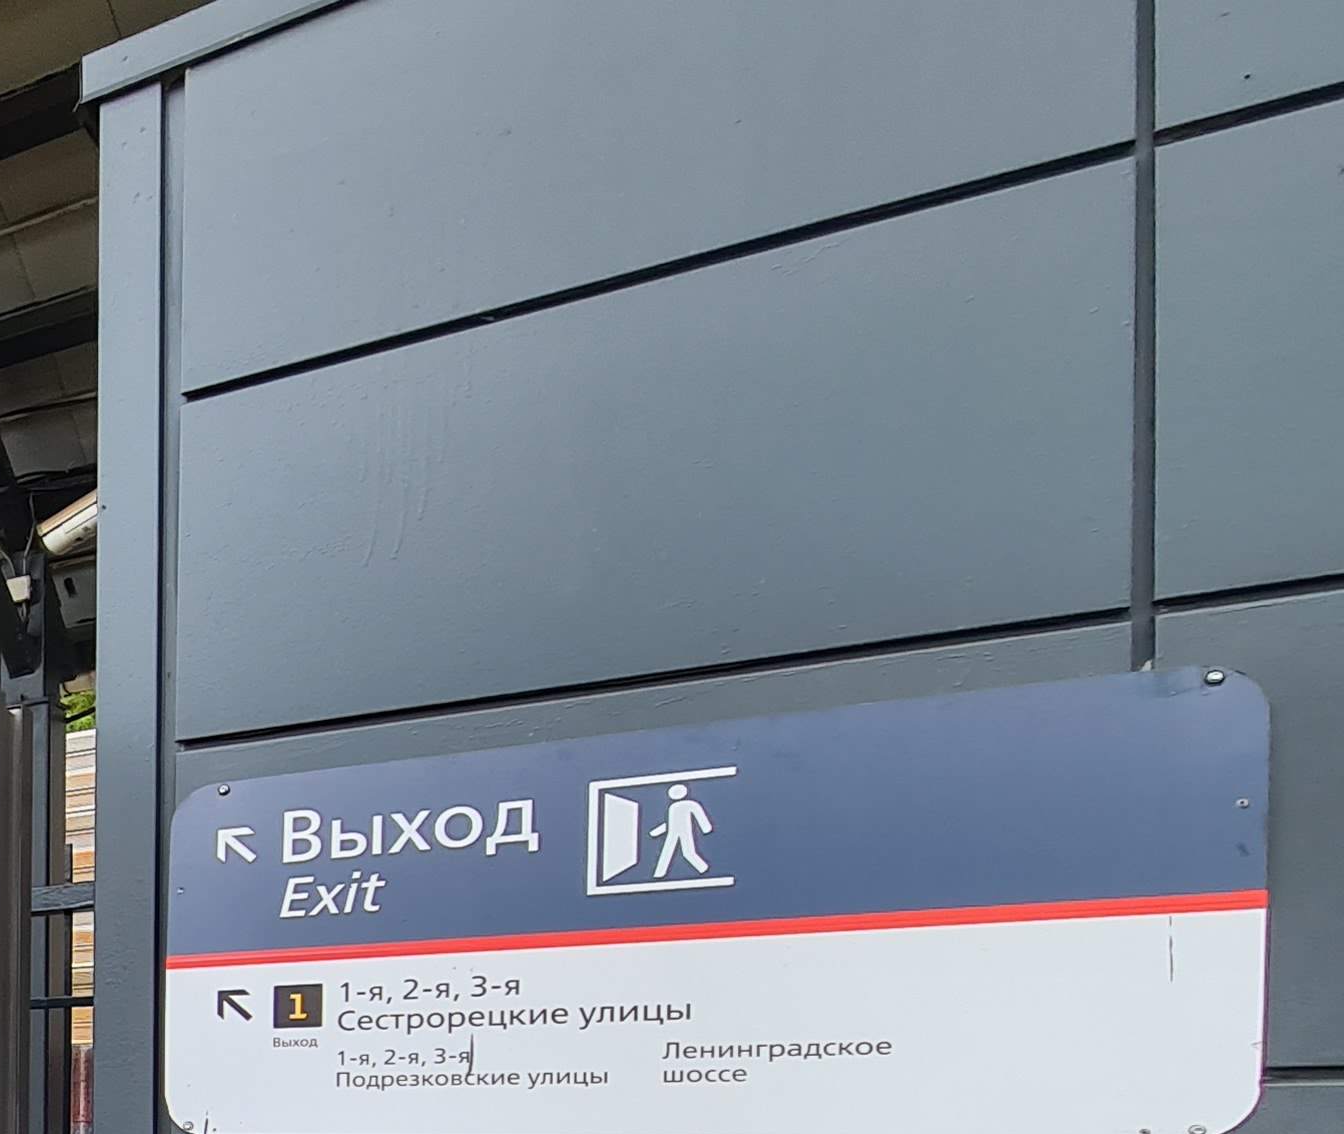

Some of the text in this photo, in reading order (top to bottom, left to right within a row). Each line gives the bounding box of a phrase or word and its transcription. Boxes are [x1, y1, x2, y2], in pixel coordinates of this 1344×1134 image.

[282, 799, 539, 864] Выход
[279, 870, 387, 918] Exit
[340, 975, 521, 1004] 1-я, 2-я, 3-я
[288, 993, 308, 1020] 1
[337, 1002, 692, 1034] Сестрорецкие улицы
[272, 1036, 318, 1049] Выход
[662, 1039, 893, 1061] Ленинградское
[337, 1047, 470, 1068] 1-я, 2-я, 3-я
[336, 1070, 609, 1091] Подрезковские улицы
[662, 1067, 748, 1084] шоссе
